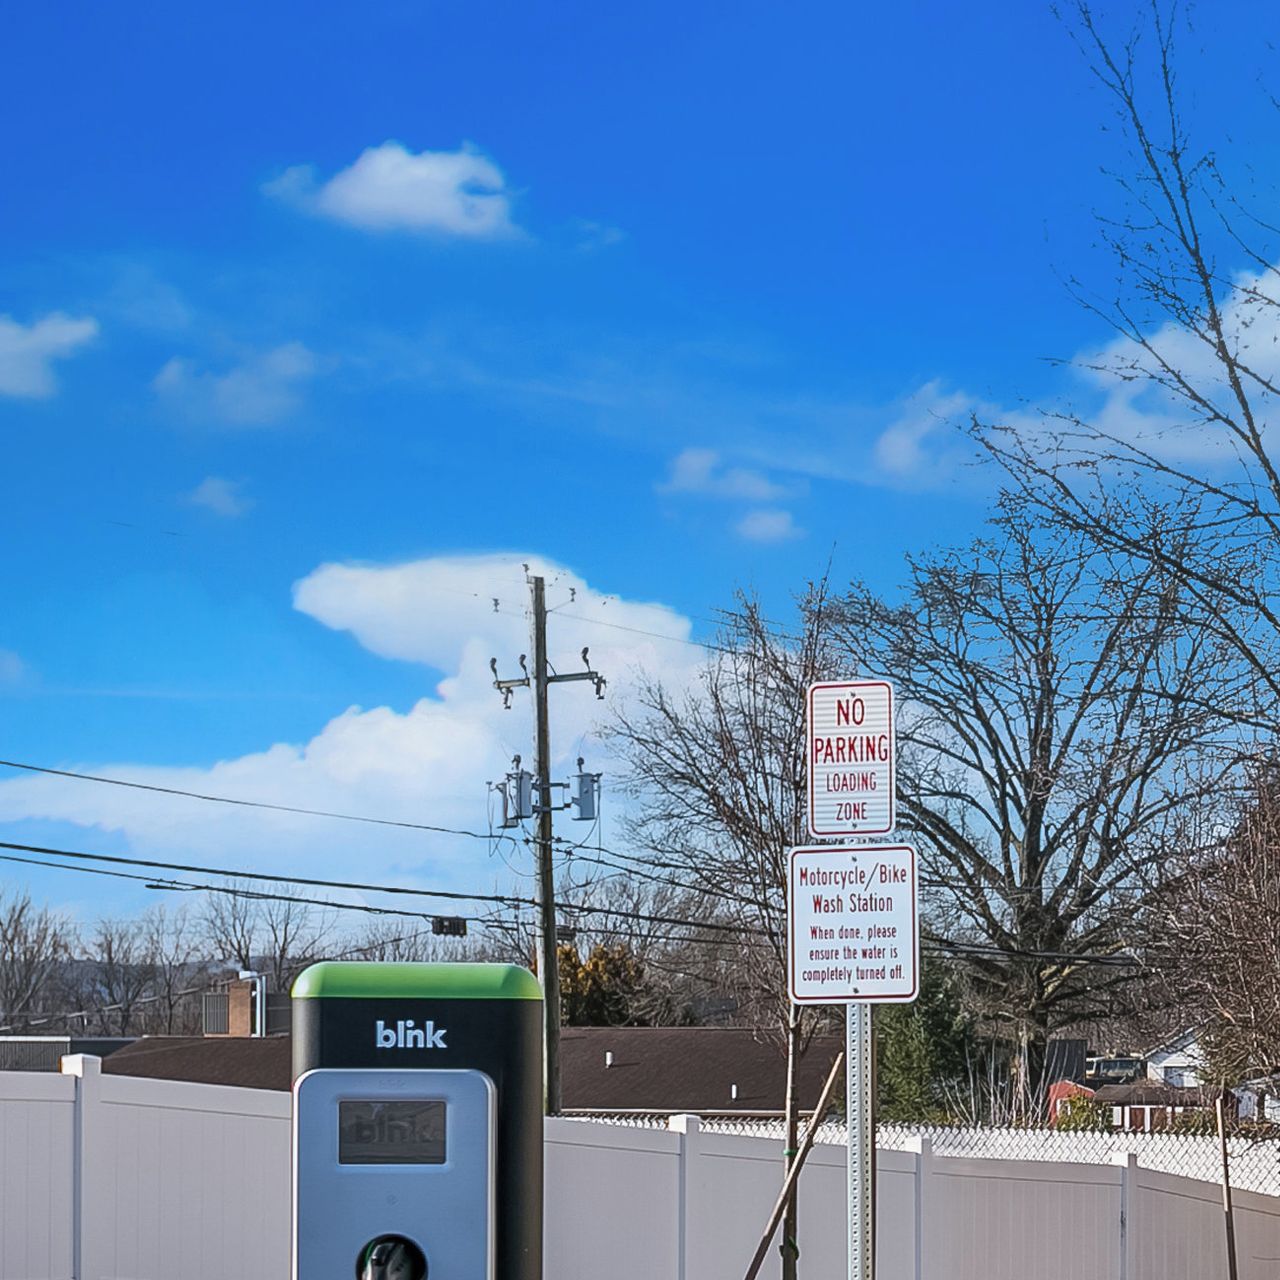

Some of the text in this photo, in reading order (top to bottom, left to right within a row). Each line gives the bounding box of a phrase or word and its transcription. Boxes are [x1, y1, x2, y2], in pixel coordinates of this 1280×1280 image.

[836, 698, 864, 726] NO
[814, 735, 888, 764] PARKING
[826, 771, 877, 792] LOADING
[836, 802, 868, 821] ZONE
[799, 863, 907, 891] Motorcycle/Bike
[812, 892, 893, 914] Wash Station
[810, 925, 834, 940] When
[867, 924, 897, 942] please
[809, 944, 898, 961] ensure the water is
[802, 964, 905, 985] completely turned off.
[376, 1020, 447, 1048] blink
